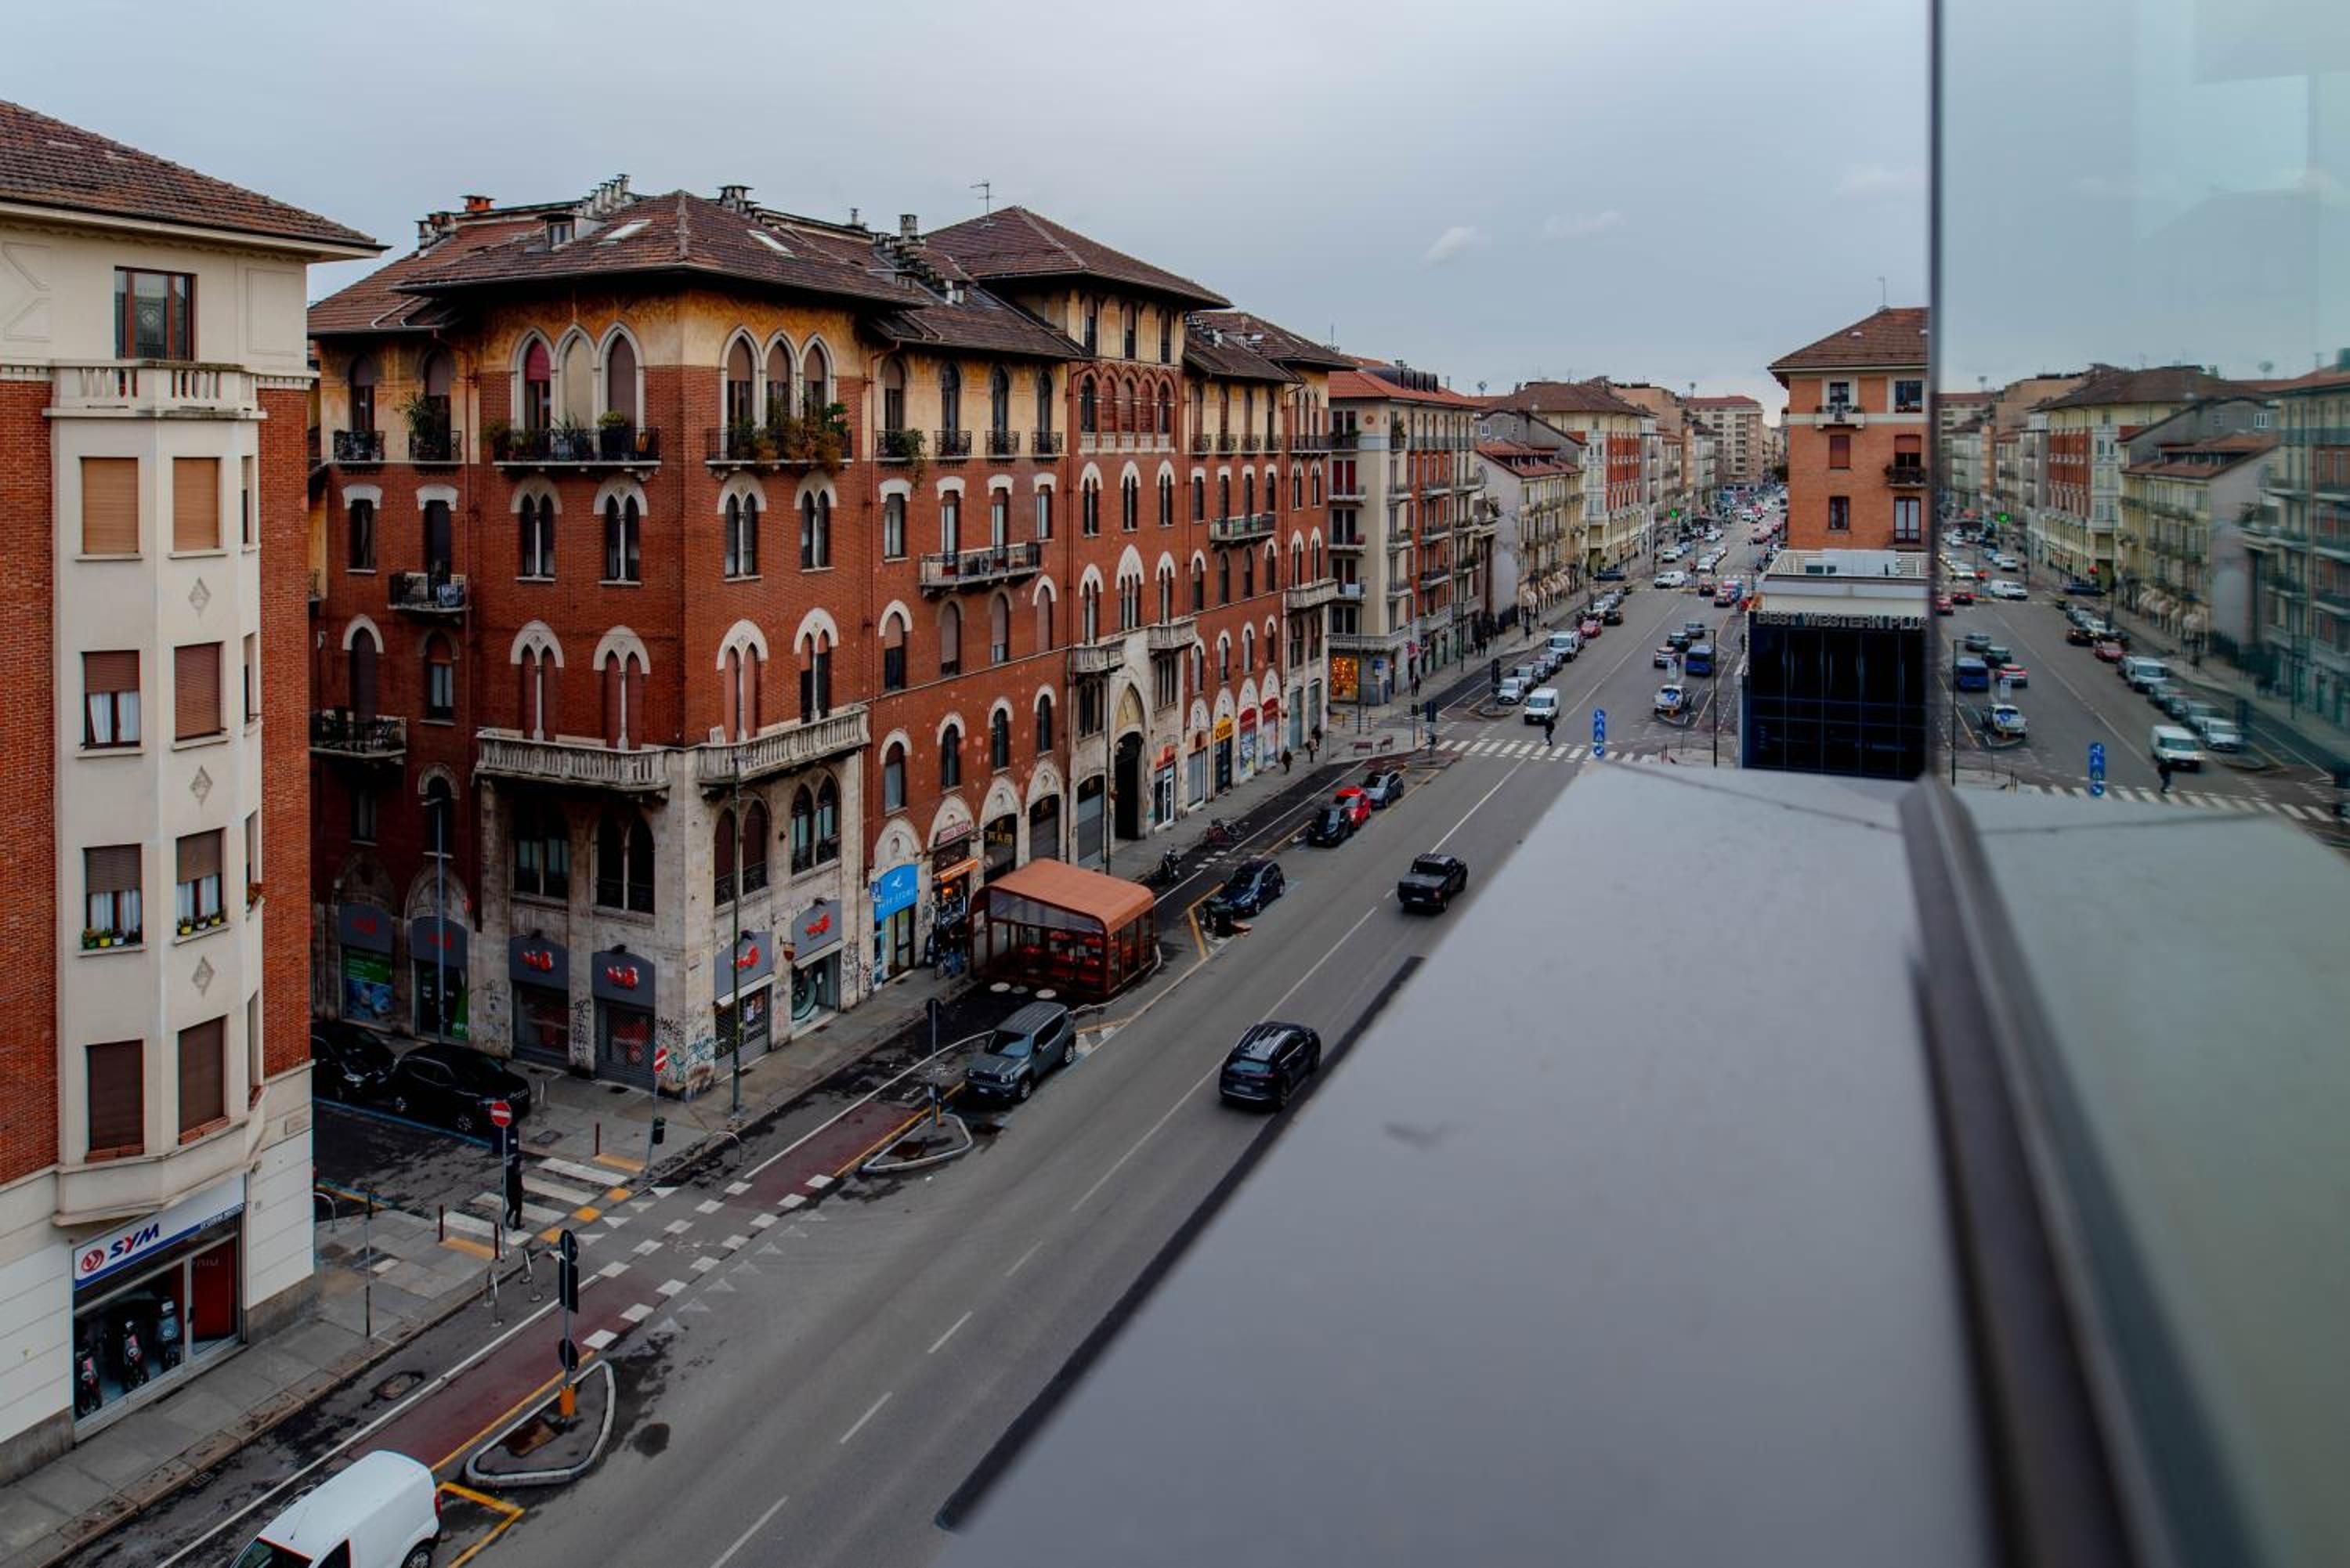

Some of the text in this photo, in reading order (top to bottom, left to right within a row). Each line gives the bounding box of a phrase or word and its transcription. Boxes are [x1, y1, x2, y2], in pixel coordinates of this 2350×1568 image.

[1756, 611, 1796, 626] BEST
[1804, 612, 1882, 629] WESTERN
[109, 1223, 160, 1259] SYM
